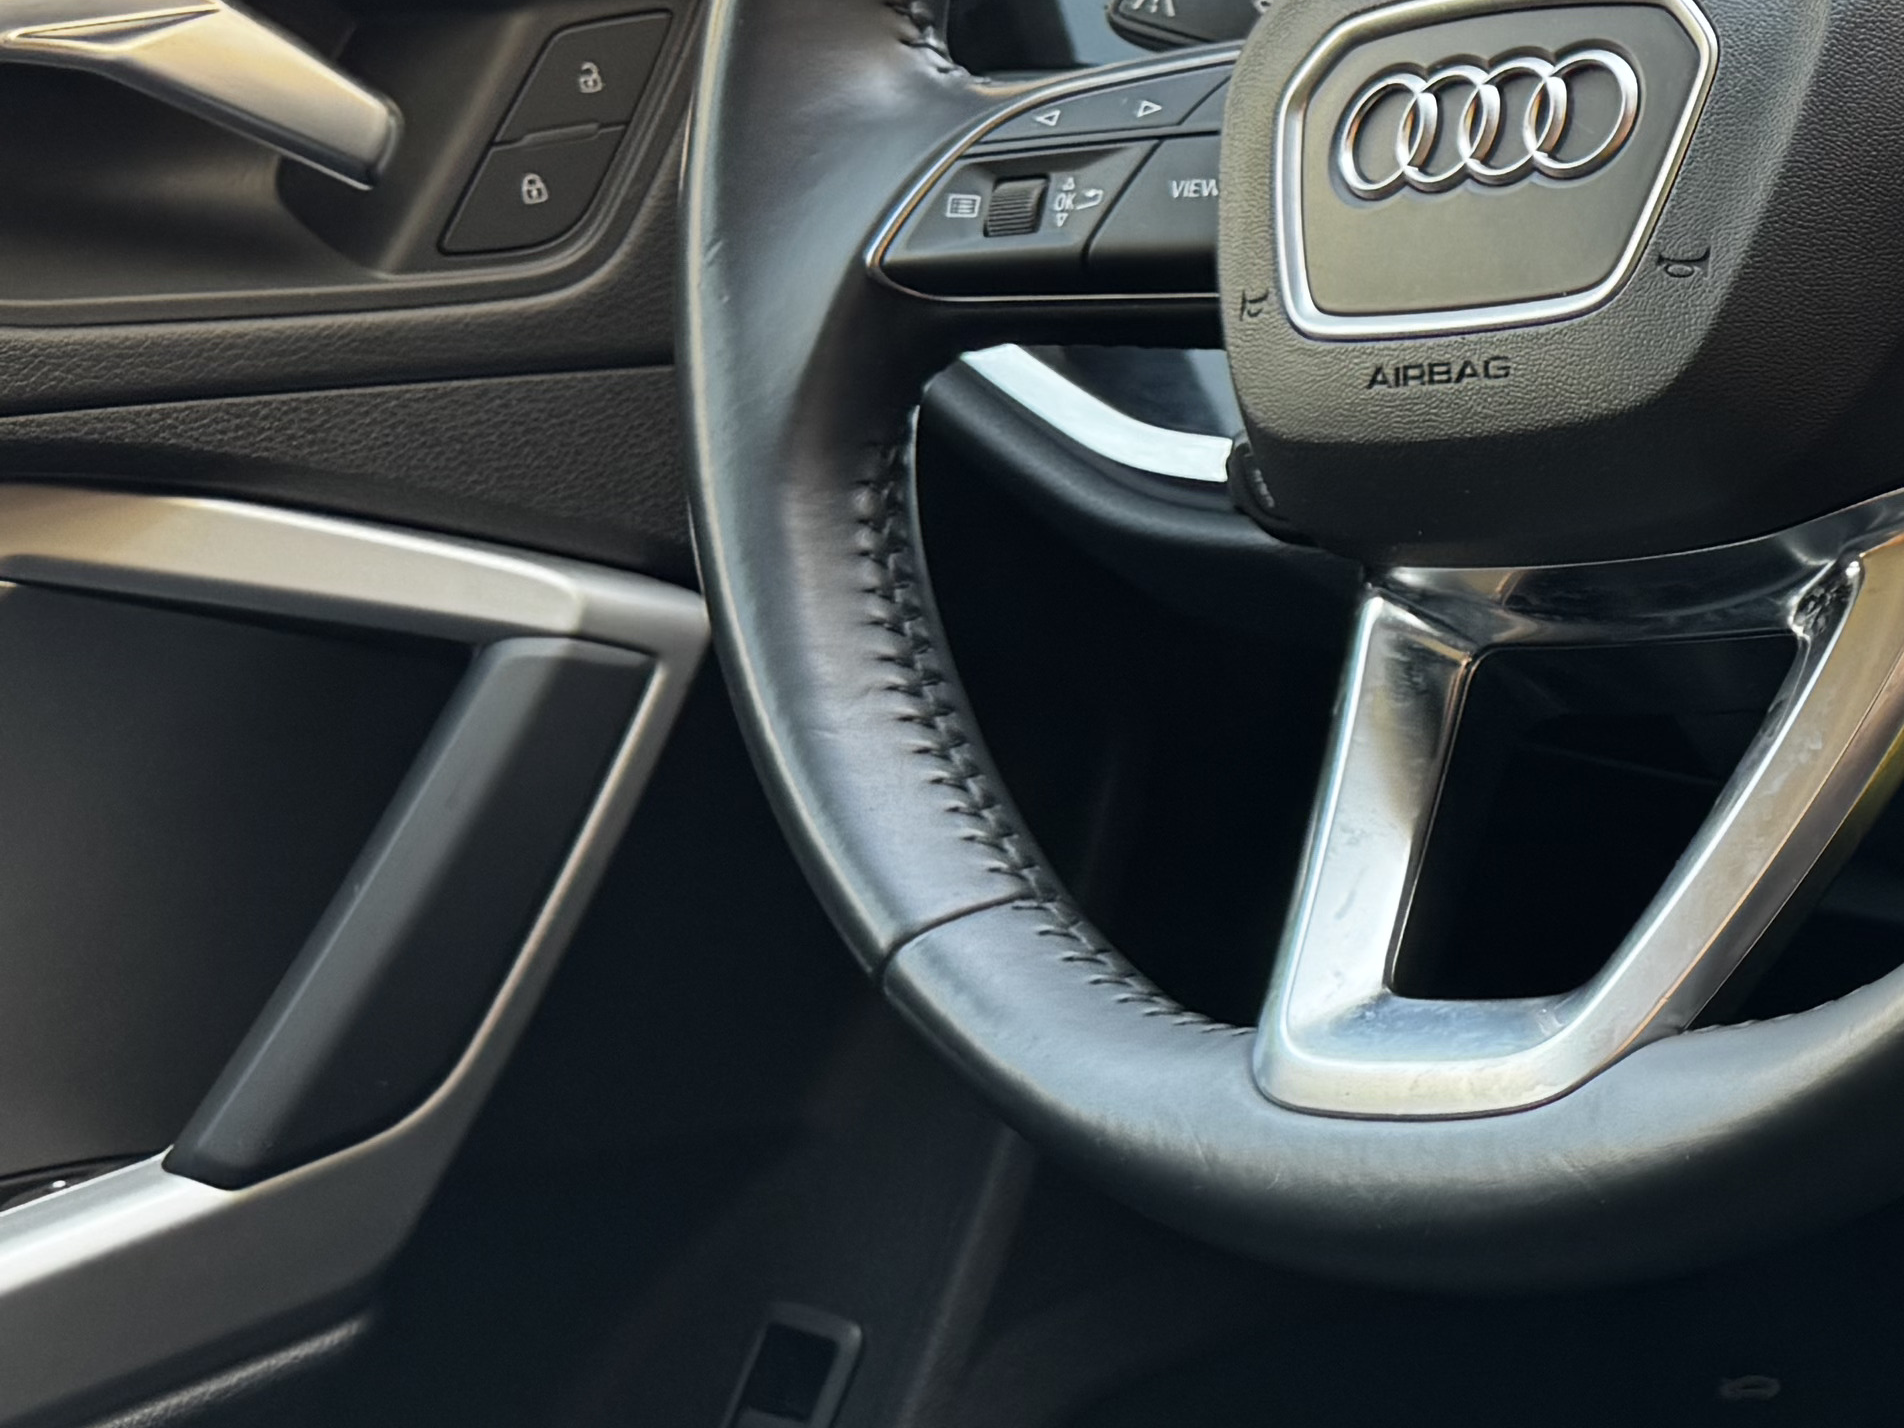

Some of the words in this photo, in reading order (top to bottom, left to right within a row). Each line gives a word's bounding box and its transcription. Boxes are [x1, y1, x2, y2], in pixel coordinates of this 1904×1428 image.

[1170, 178, 1219, 199] VIEW
[1054, 193, 1076, 211] OK
[1366, 356, 1511, 390] AIRBAG
